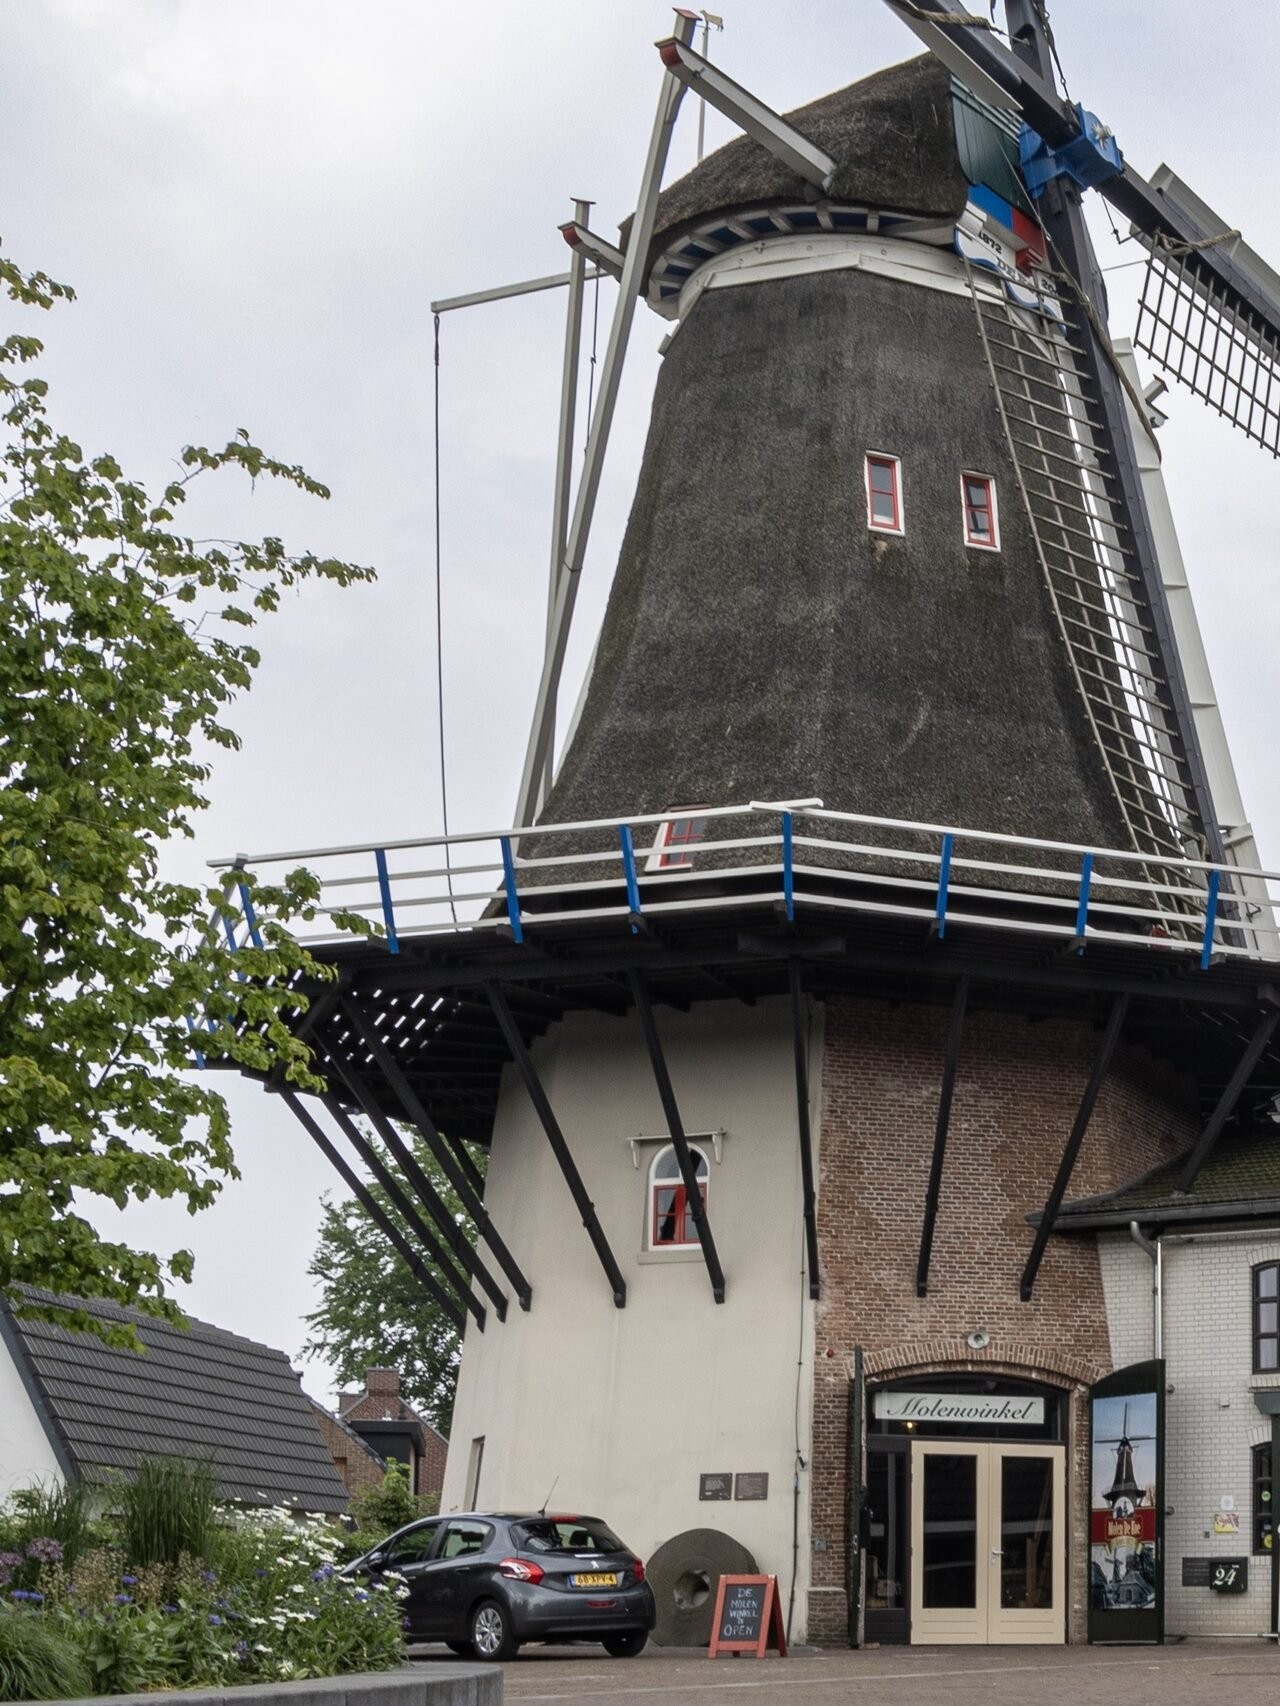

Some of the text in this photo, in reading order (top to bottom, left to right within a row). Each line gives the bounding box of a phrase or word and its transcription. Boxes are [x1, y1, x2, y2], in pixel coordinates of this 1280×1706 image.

[979, 231, 1002, 254] 1872
[887, 1396, 1036, 1420] Molenwinkel
[1213, 1567, 1237, 1586] 24
[738, 1588, 753, 1598] DE
[731, 1599, 758, 1609] MOLEN
[724, 1624, 754, 1637] OPEN
